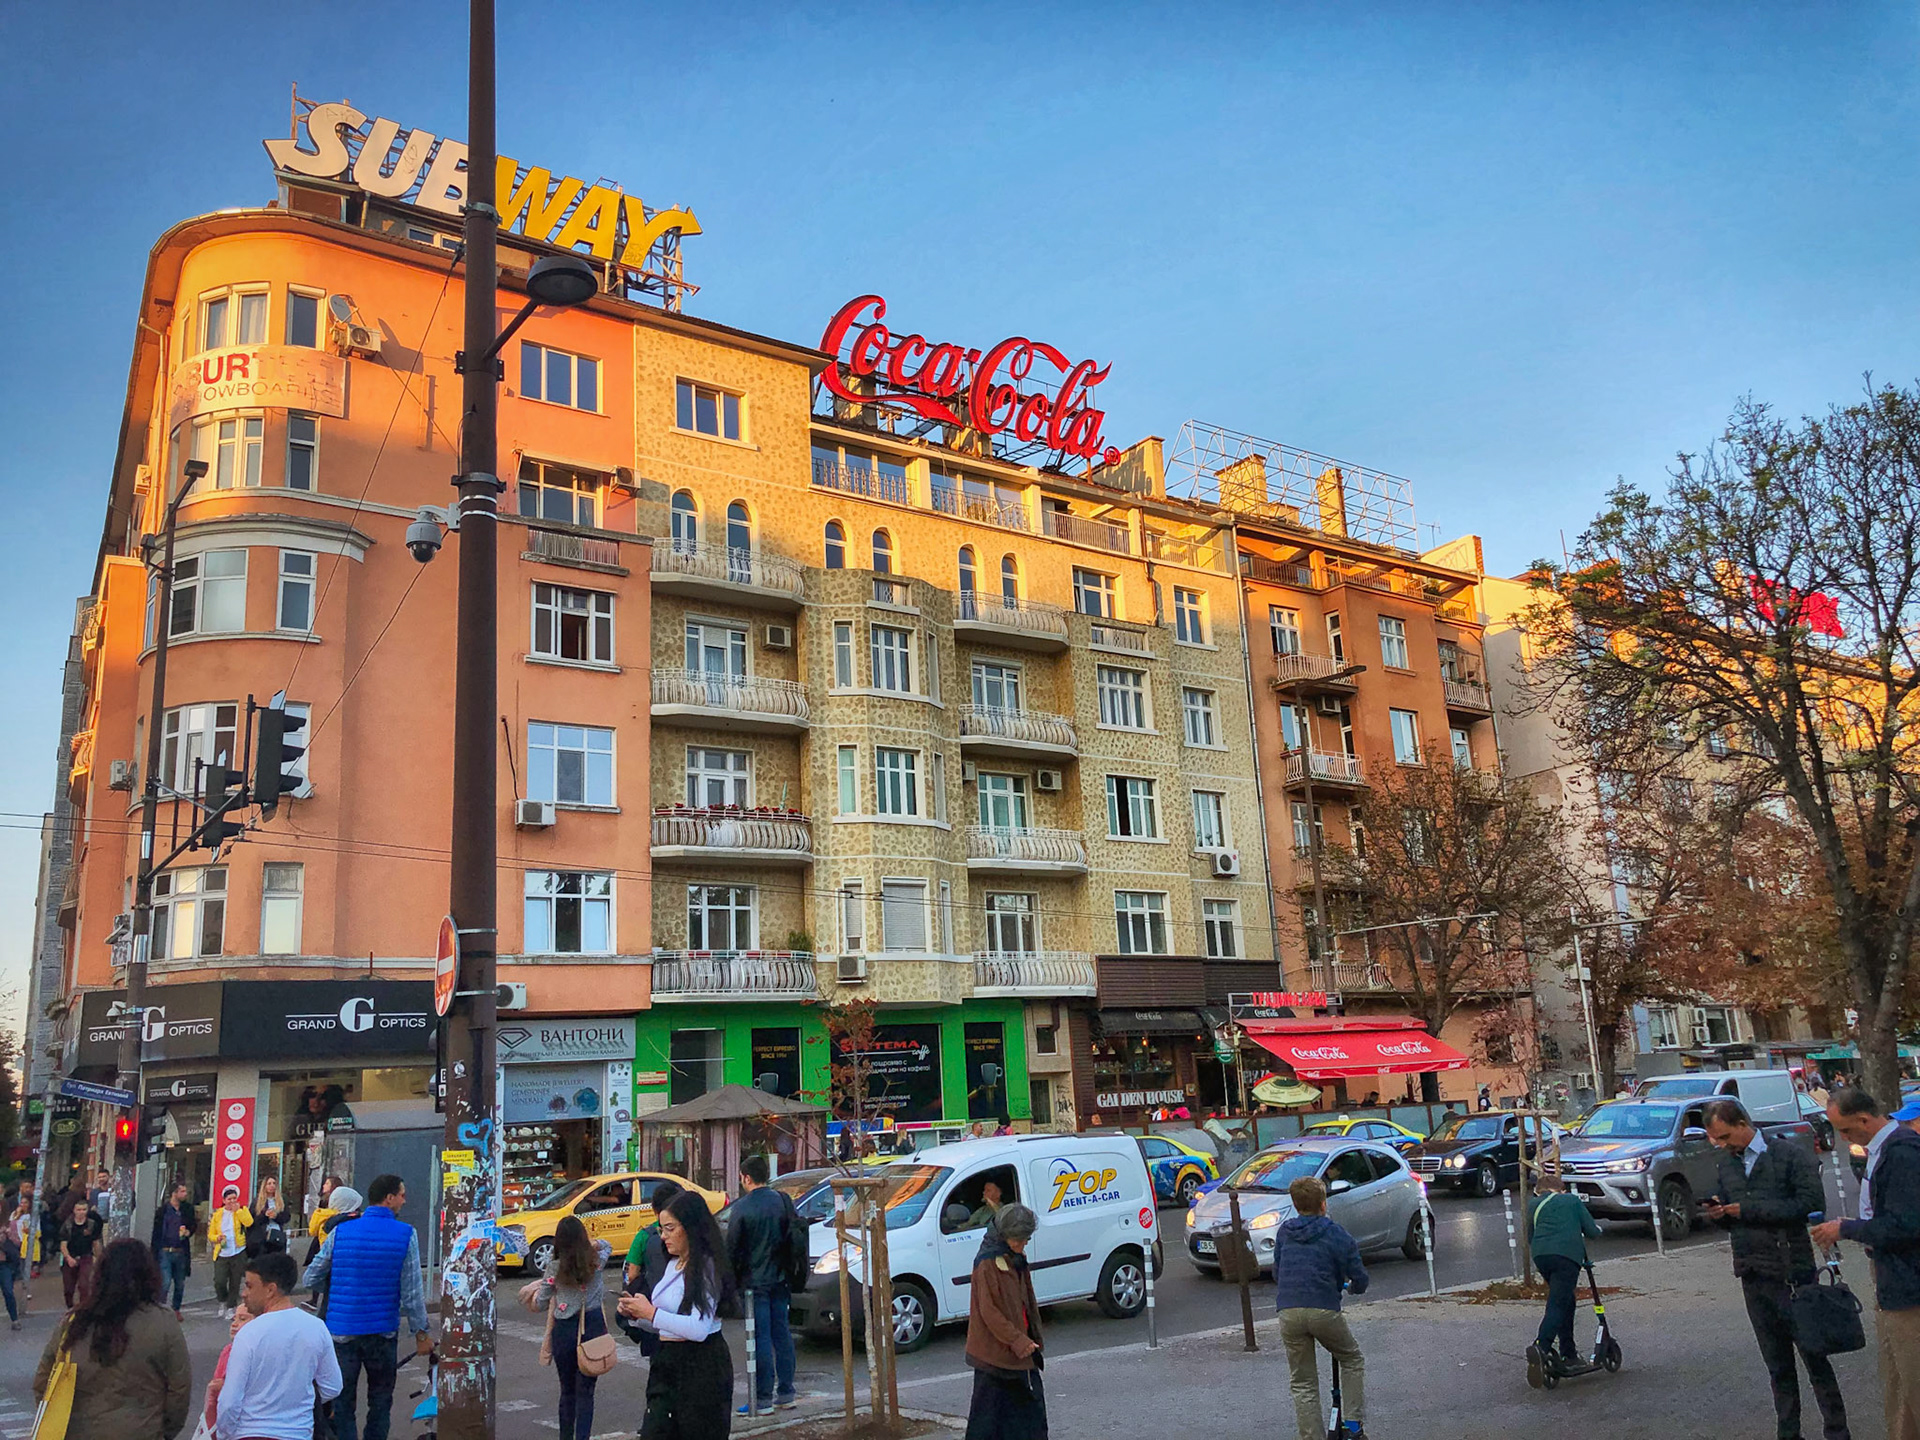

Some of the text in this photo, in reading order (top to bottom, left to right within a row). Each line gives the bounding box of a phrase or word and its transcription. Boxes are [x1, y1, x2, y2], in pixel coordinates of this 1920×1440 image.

[263, 102, 704, 268] SUBWAY
[819, 294, 1113, 459] Coca-Cola
[89, 1006, 213, 1042] GRAN G OPTICS
[287, 997, 427, 1033] GRAND G OPTICS
[541, 1028, 624, 1042] ВАНТОНИ
[1291, 1041, 1432, 1060] Coca-Cola Coca-Cola
[171, 1080, 187, 1097] G
[511, 1080, 550, 1088] HANDMADE
[1145, 1090, 1186, 1105] HOUSE
[295, 1121, 326, 1136] GUE
[1048, 1168, 1118, 1213] TOP
[1063, 1191, 1121, 1208] RENT-A-CAR
